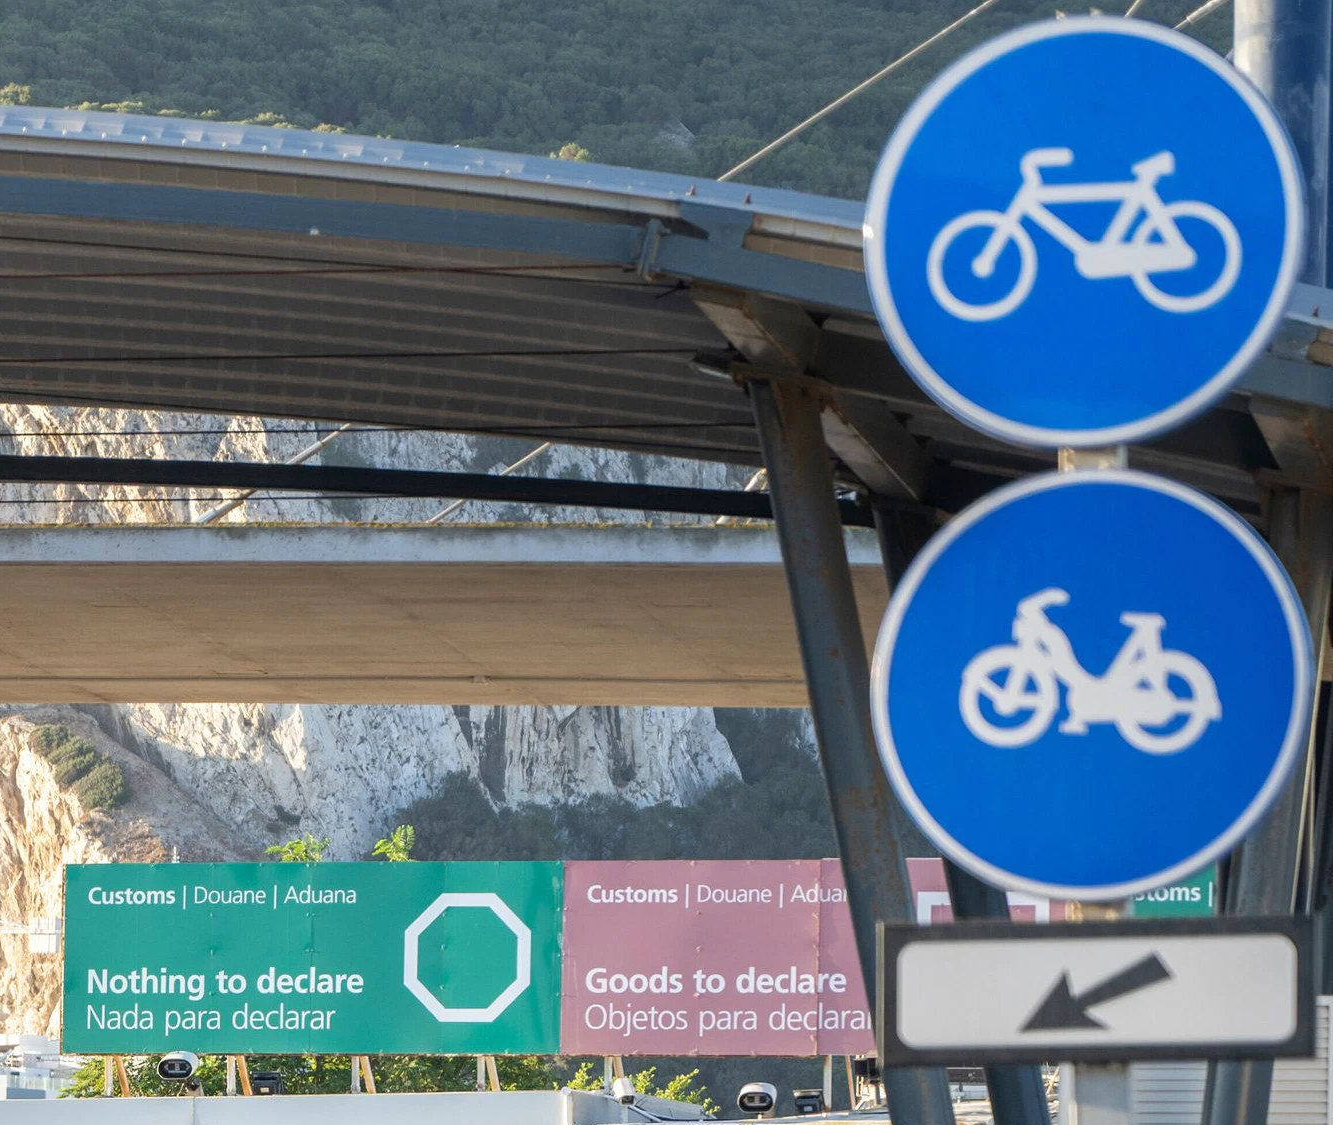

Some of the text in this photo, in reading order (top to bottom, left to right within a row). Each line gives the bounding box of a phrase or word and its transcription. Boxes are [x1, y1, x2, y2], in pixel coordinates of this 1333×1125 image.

[88, 885, 357, 905] Customs Douane Aduana
[586, 885, 678, 904] Customs
[697, 885, 772, 903] Douane
[87, 966, 364, 1001] Nothing to declare
[585, 966, 847, 994] Goods to declare
[86, 1002, 336, 1036] Nada para declarar
[585, 1002, 688, 1037] Objetos
[699, 1009, 757, 1037] para
